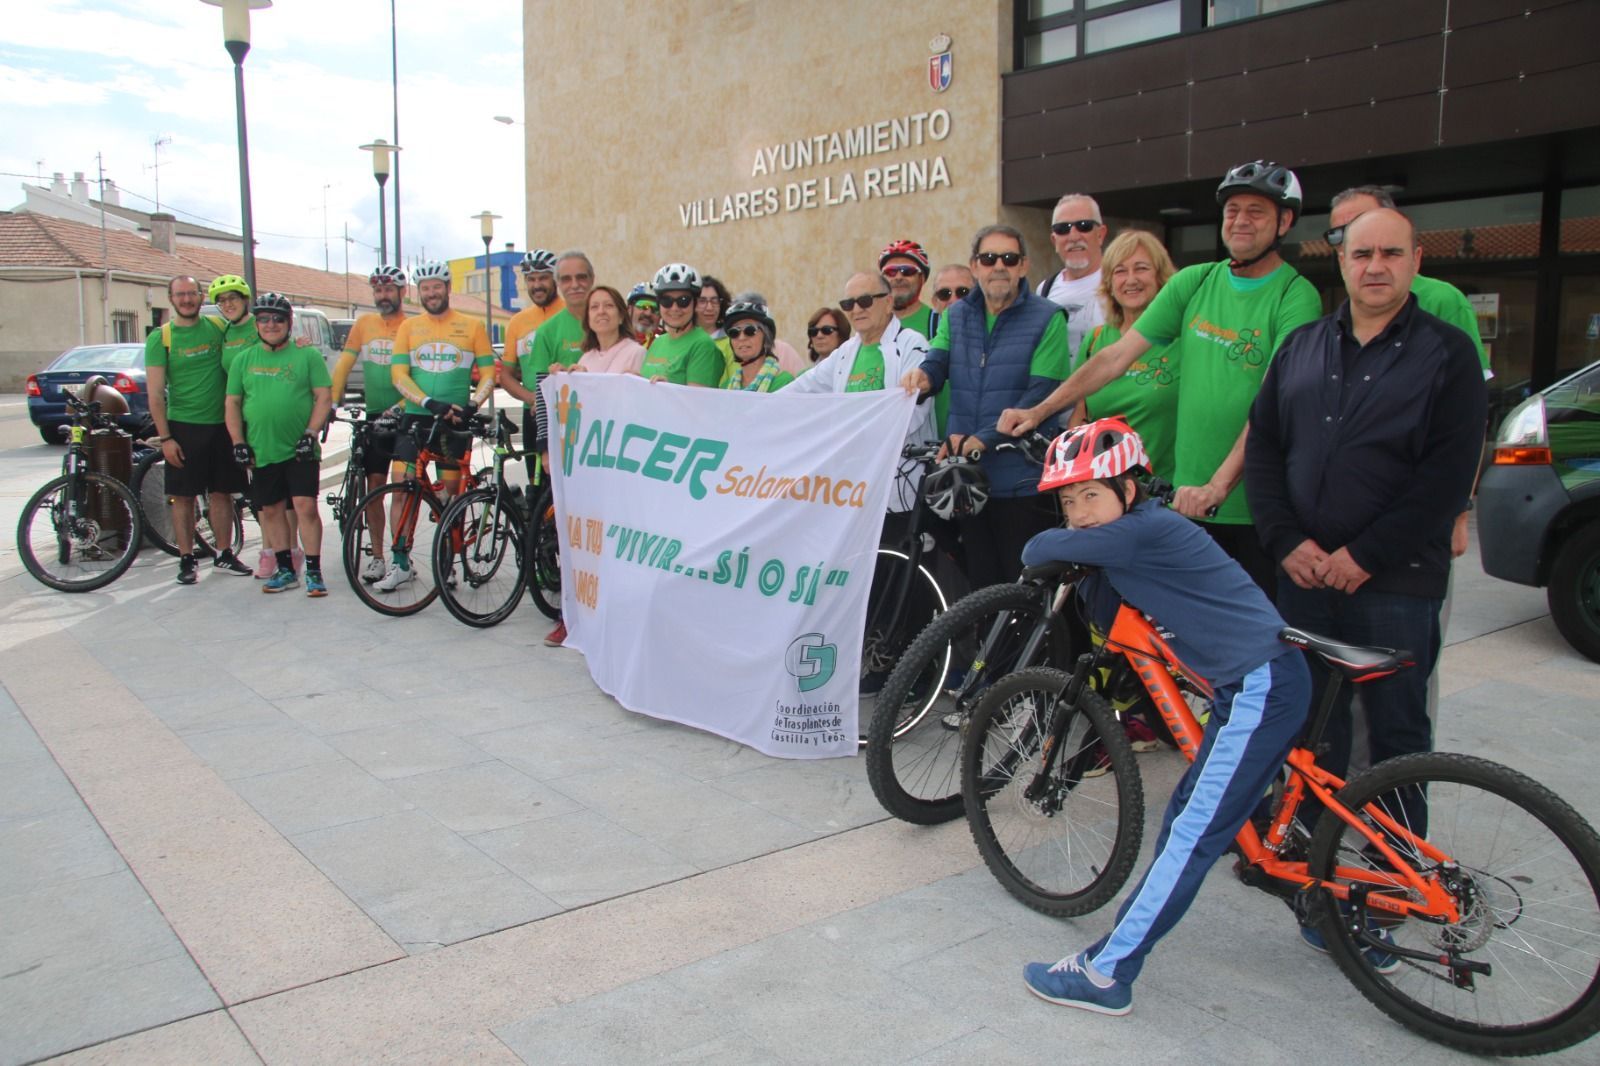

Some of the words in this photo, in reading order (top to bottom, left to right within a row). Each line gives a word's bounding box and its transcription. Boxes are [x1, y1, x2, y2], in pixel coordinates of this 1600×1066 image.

[751, 108, 951, 177] AYUNTAMIENTO
[679, 187, 779, 228] VILLARES
[785, 178, 818, 213] DE
[824, 173, 859, 206] LA
[864, 156, 952, 199] REINA
[579, 419, 729, 500] ALCER
[716, 464, 868, 508] Salamanca
[758, 559, 785, 597] O
[775, 716, 783, 726] de
[784, 717, 831, 731] Trasplantes
[832, 716, 842, 727] de
[776, 700, 840, 715] Coordinación
[771, 730, 809, 744] Castilla
[813, 736, 819, 746] y
[822, 732, 846, 743] León
